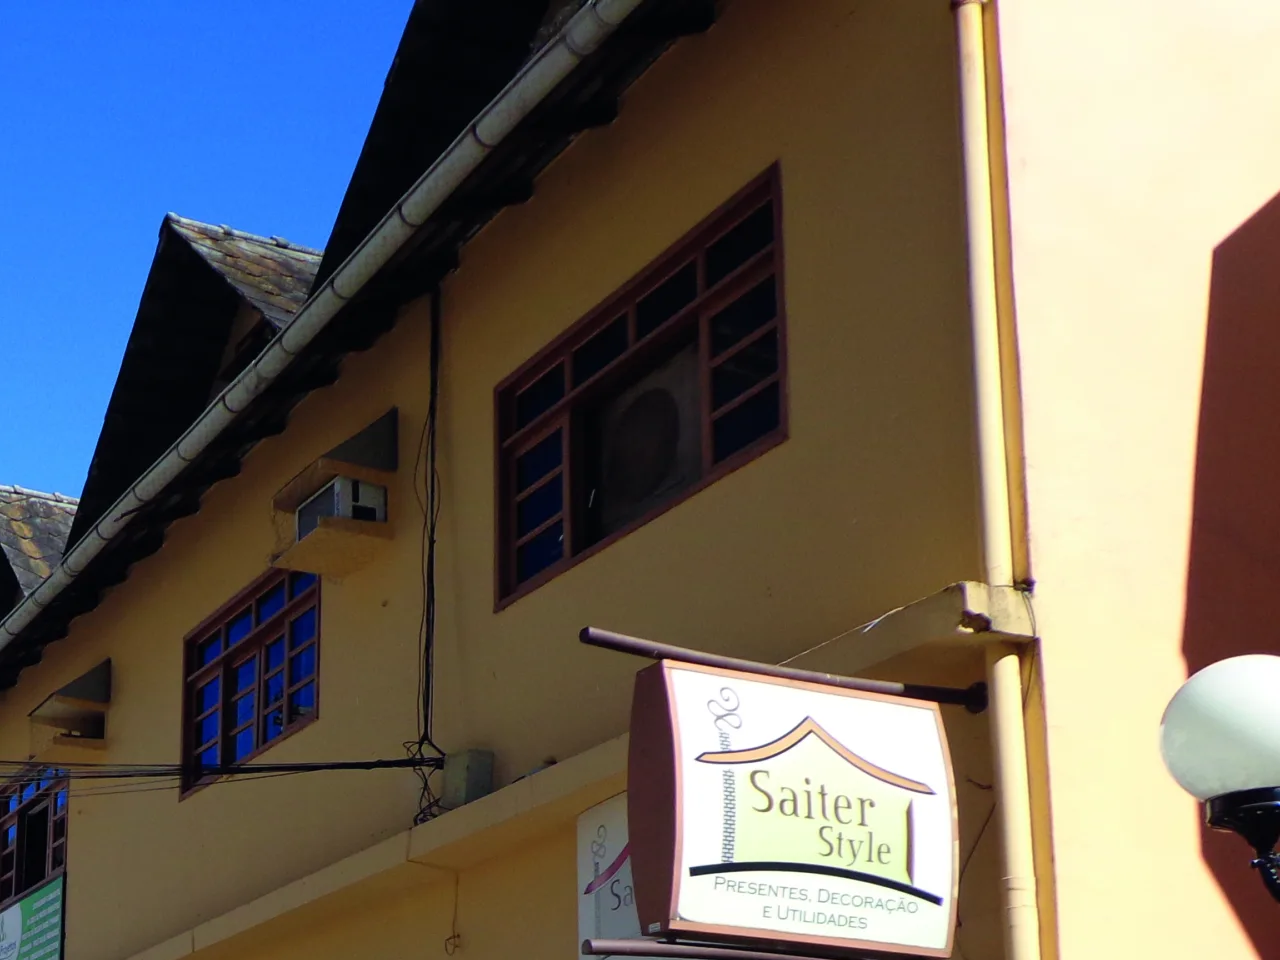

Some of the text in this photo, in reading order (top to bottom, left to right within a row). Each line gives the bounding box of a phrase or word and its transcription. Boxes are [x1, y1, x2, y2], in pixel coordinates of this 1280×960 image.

[749, 769, 876, 827] Saiter
[818, 825, 892, 866] Style
[777, 906, 868, 930] UTILIDADES
[818, 888, 919, 915] DECORAÇÃO
